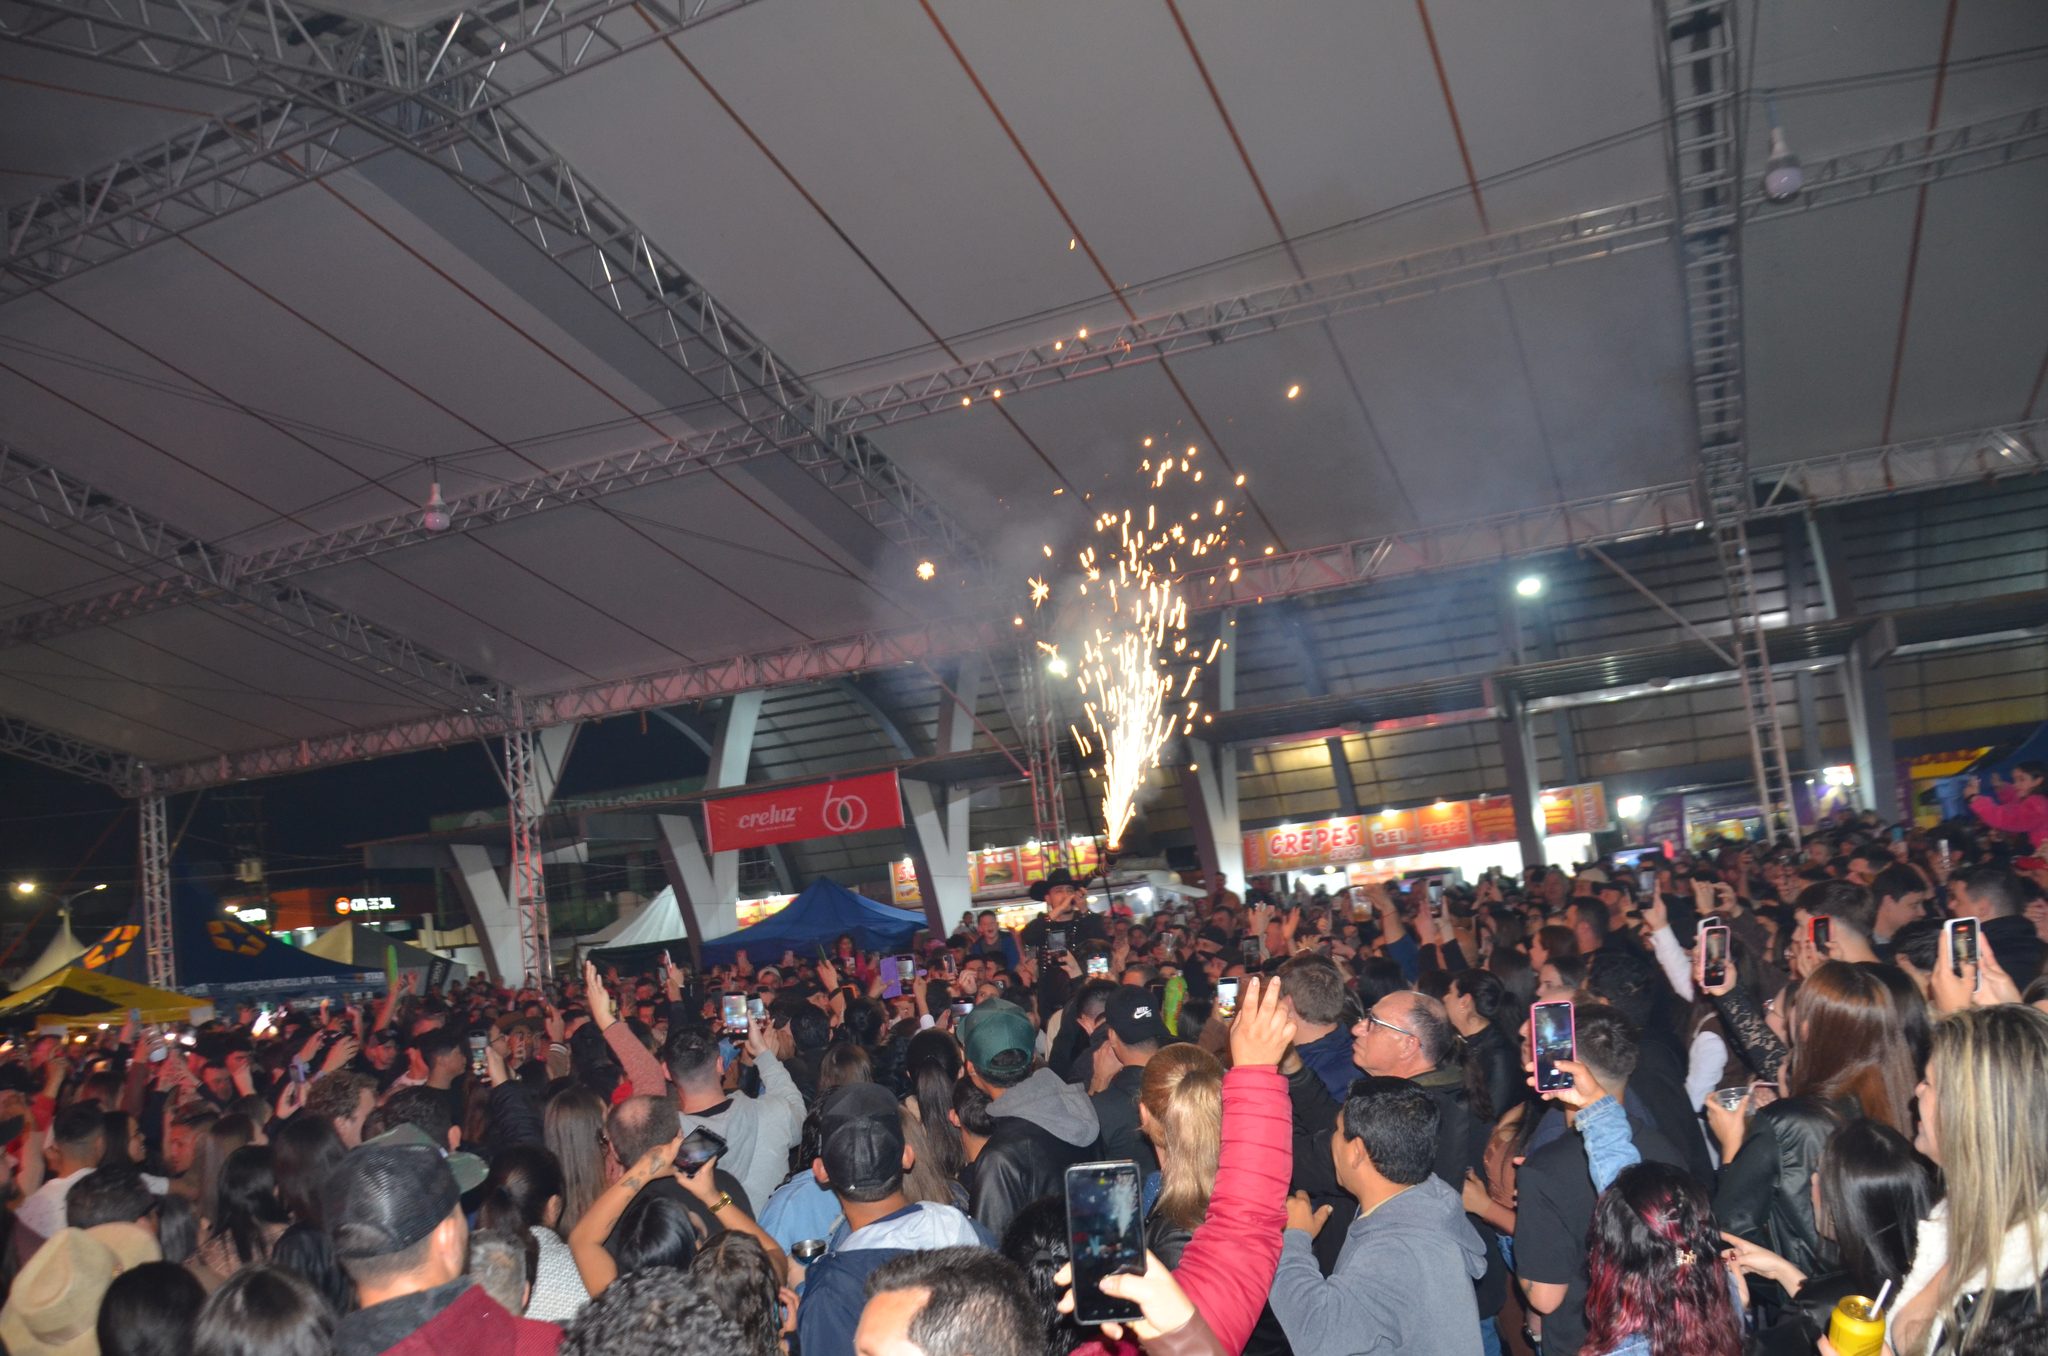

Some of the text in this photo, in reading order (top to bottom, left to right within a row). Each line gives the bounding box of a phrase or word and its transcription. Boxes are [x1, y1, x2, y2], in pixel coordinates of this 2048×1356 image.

[738, 785, 868, 832] creluz 60
[1269, 823, 1361, 857] CREPES
[1373, 827, 1408, 847] REI
[983, 852, 1014, 865] XIS
[313, 975, 337, 985] TOTAL
